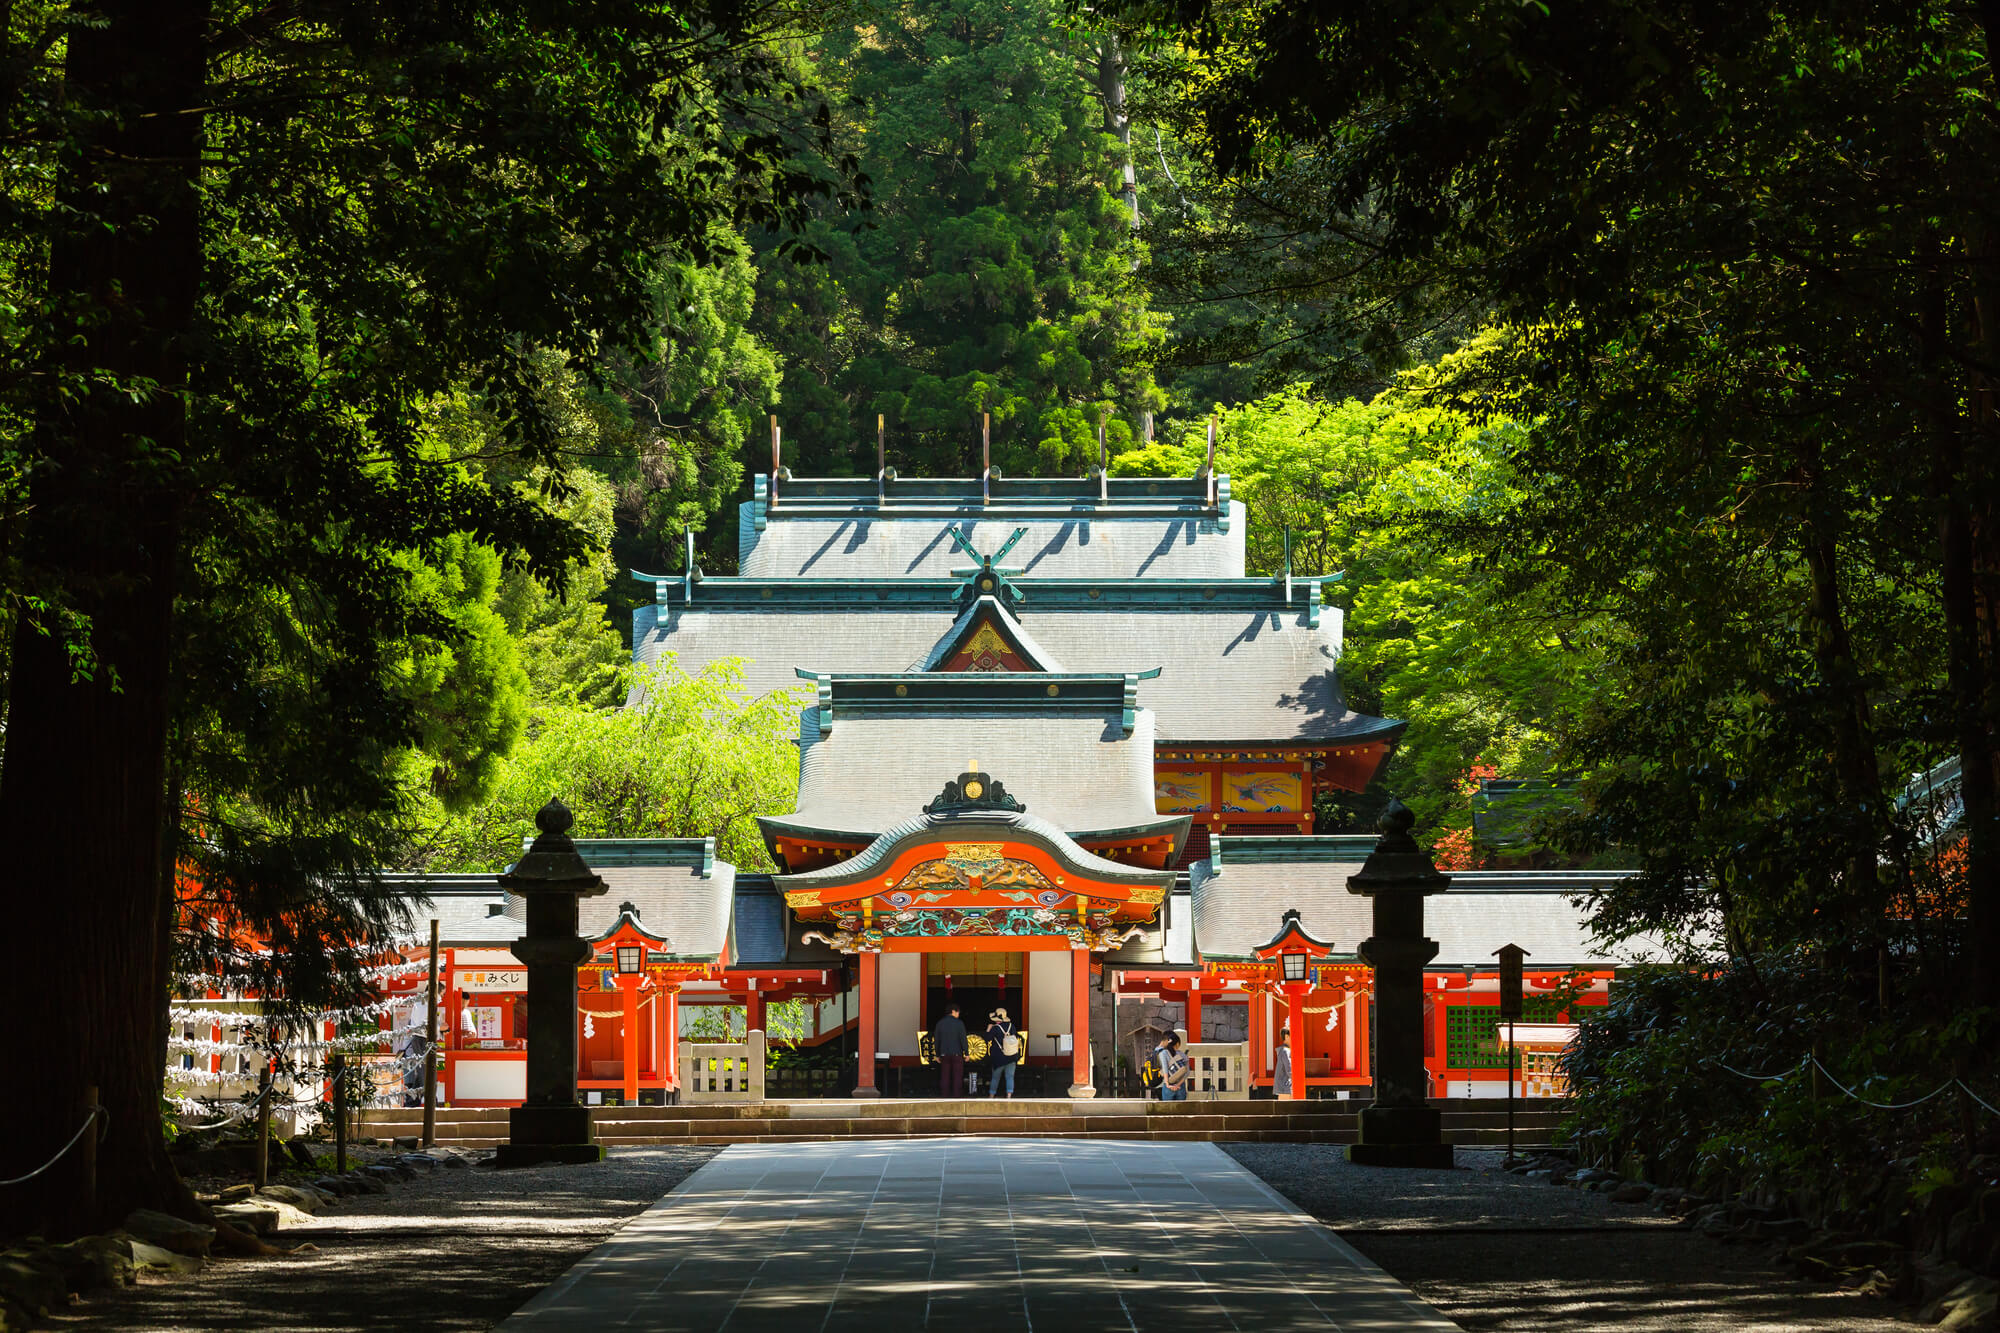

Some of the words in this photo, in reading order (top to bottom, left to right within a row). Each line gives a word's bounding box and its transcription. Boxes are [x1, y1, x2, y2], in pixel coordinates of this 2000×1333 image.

[463, 972, 520, 984] 幸福みくじ
